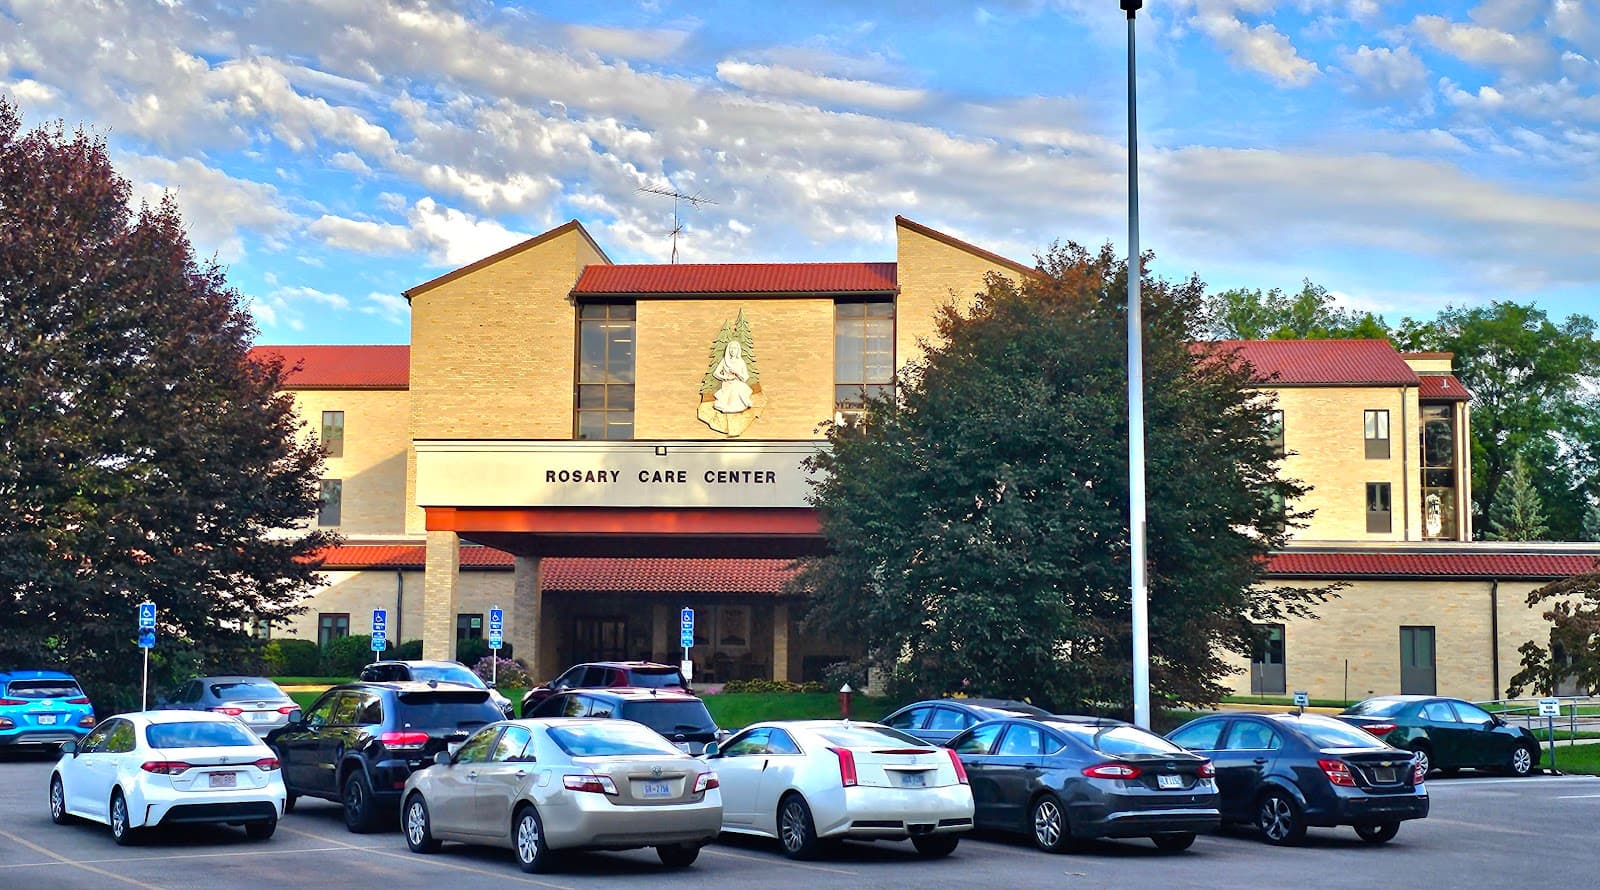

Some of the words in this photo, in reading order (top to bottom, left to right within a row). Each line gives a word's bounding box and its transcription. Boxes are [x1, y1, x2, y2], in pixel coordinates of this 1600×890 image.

[546, 470, 620, 483] ROSARY
[638, 470, 687, 483] CARE
[704, 470, 776, 484] CENTER
